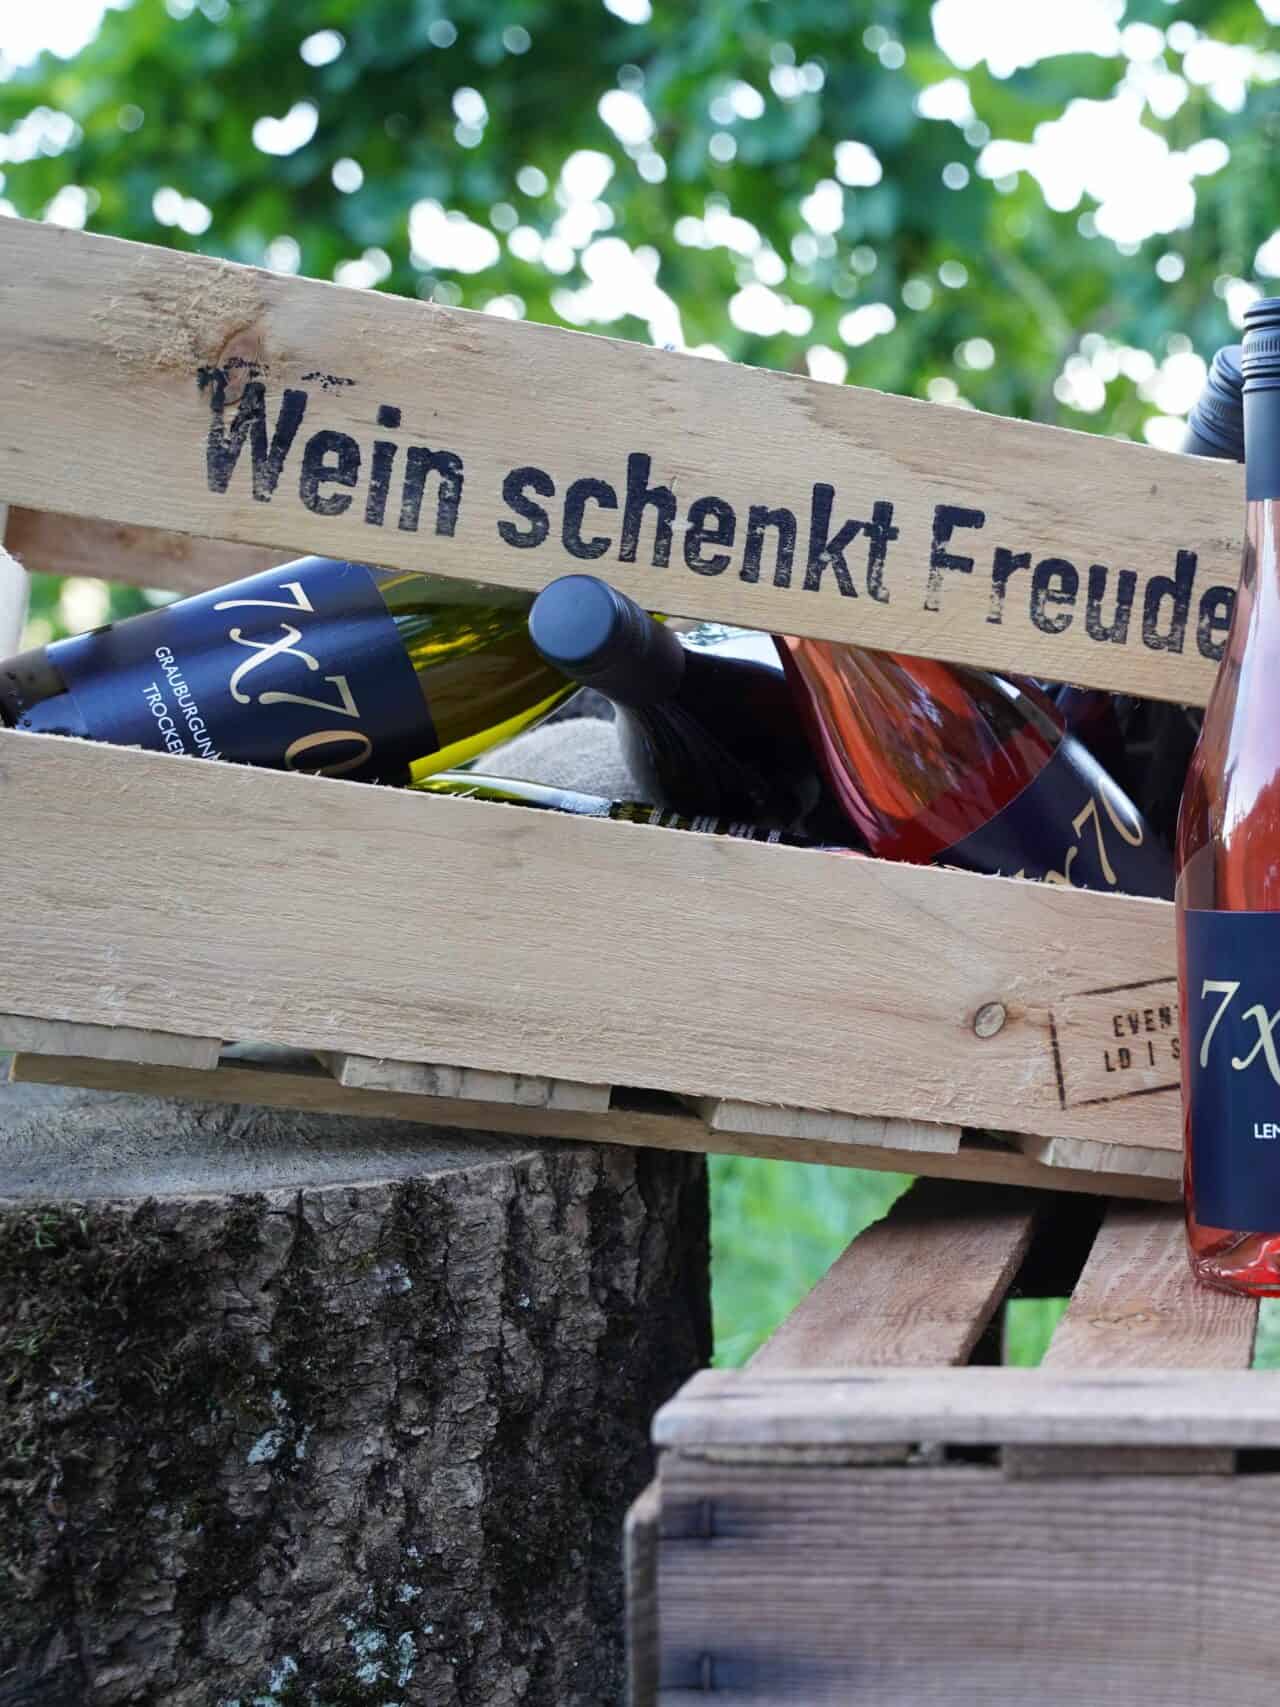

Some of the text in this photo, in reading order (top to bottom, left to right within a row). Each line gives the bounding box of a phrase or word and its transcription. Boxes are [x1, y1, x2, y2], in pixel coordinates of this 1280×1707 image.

[198, 358, 1237, 663] Wein schenkt Freude
[155, 646, 218, 760] GRAUBURGUN
[1113, 1004, 1179, 1037] EVEN
